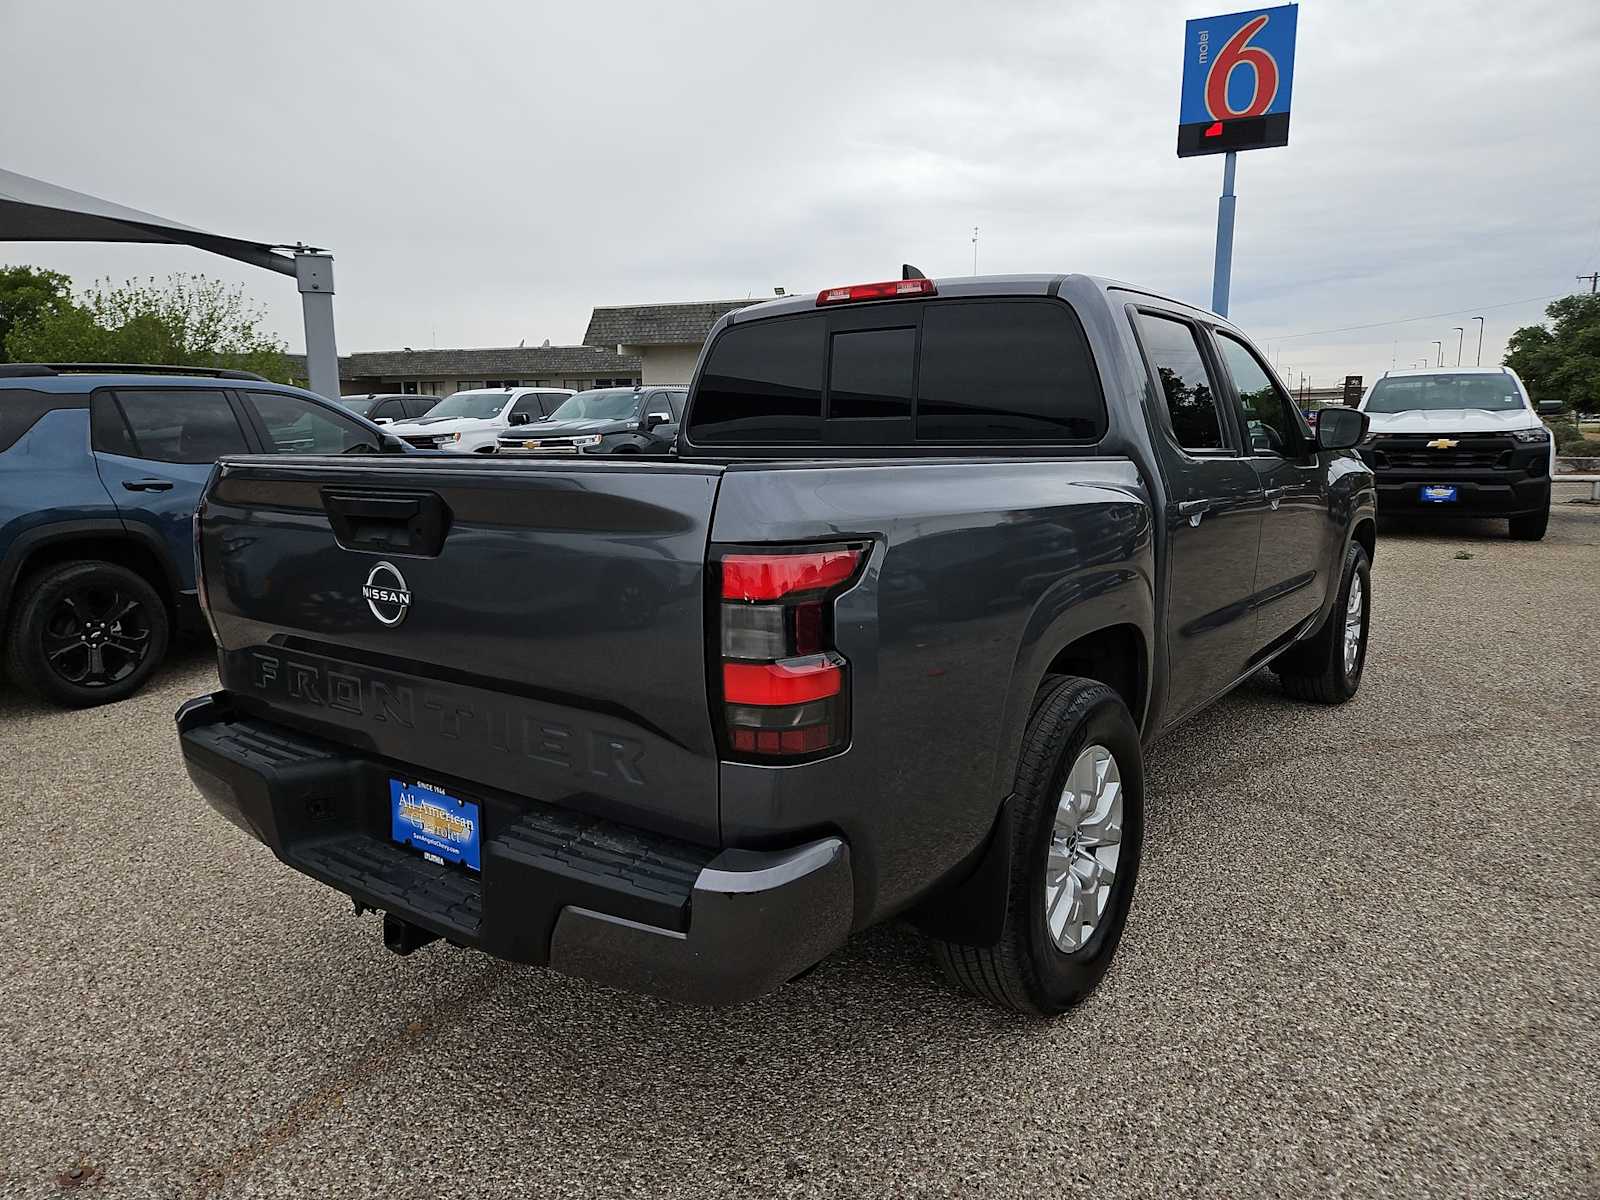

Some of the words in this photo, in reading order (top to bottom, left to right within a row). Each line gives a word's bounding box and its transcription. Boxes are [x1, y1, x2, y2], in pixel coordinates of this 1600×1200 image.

[1198, 31, 1209, 64] motel
[1204, 15, 1279, 120] 6
[363, 586, 409, 604] NISSAN
[251, 652, 648, 785] FRONTIER
[416, 780, 434, 792] SINCE
[399, 792, 415, 809] All
[419, 799, 474, 831] American
